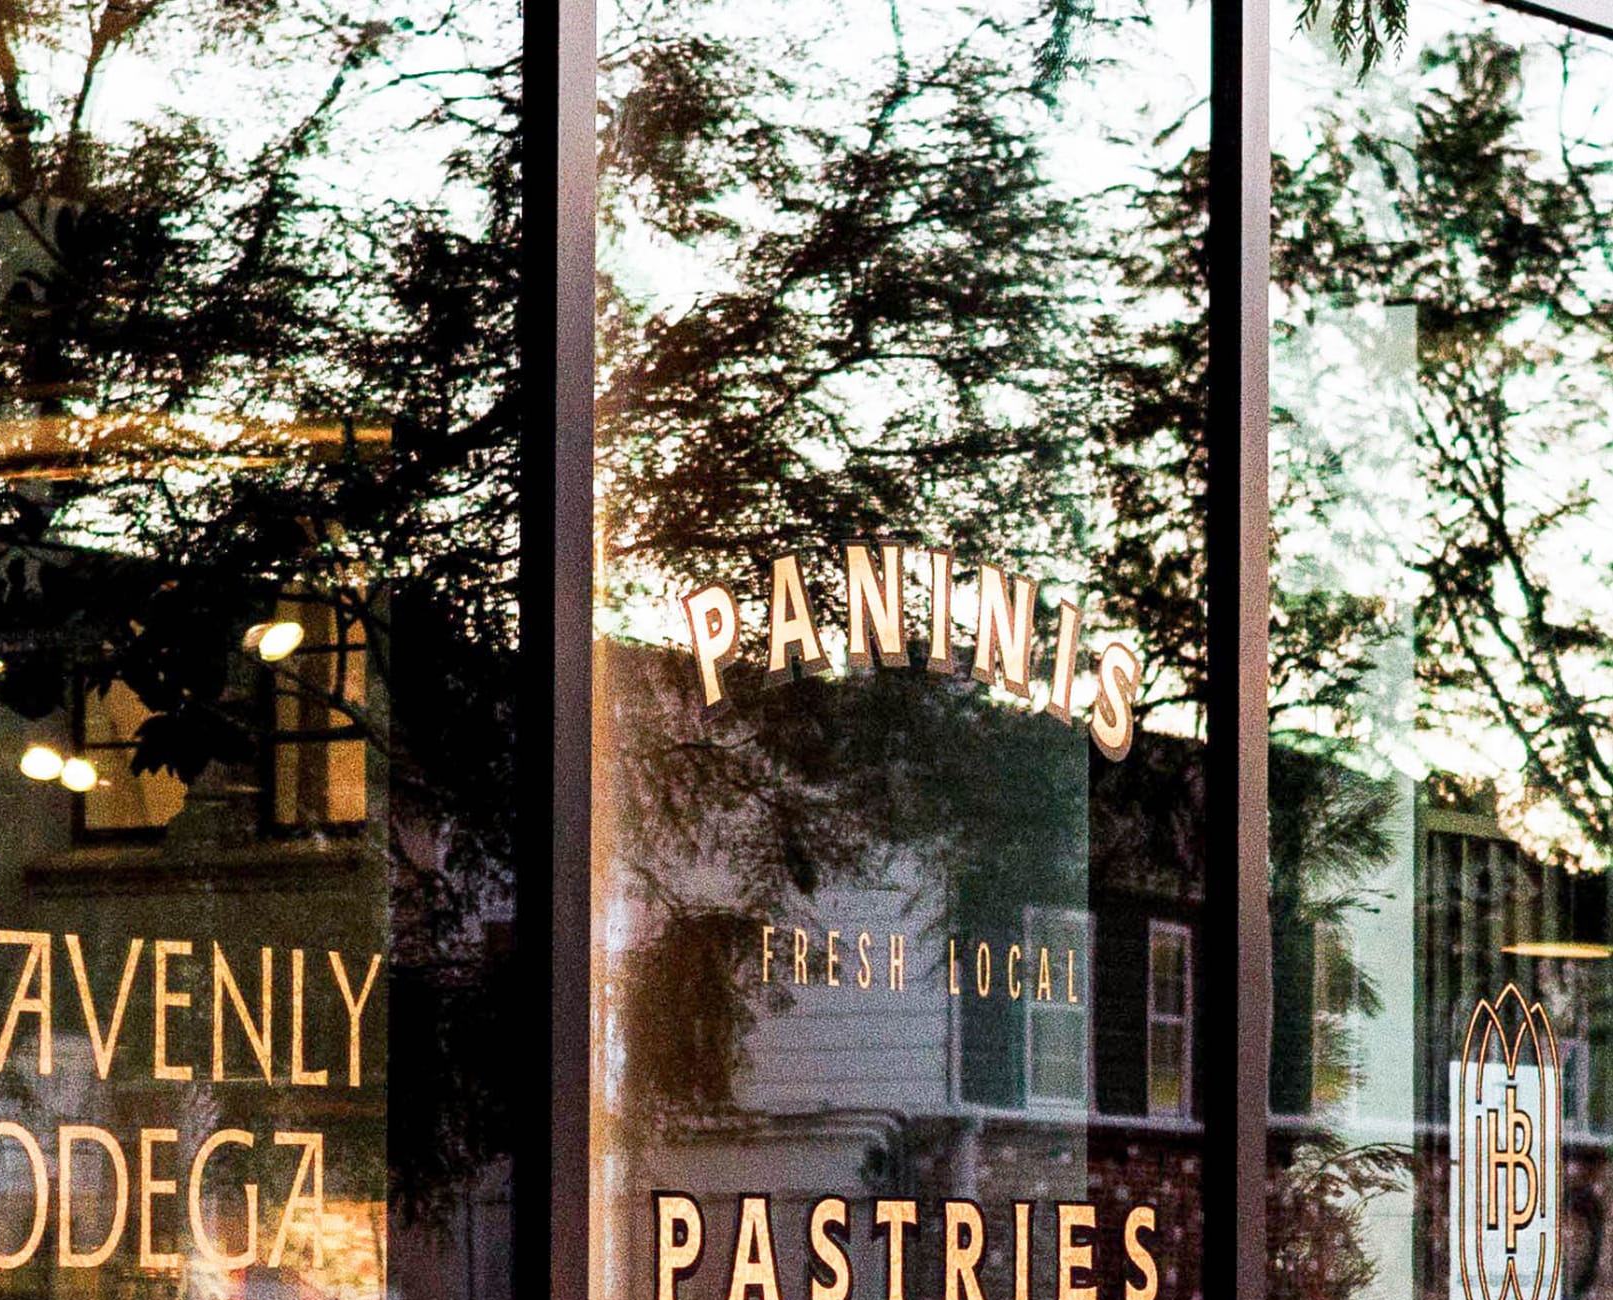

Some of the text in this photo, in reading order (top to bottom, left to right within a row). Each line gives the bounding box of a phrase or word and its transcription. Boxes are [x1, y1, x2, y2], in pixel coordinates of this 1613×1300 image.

[681, 539, 1142, 763] PANINIS
[762, 926, 1078, 1003] FRESH LOCAL
